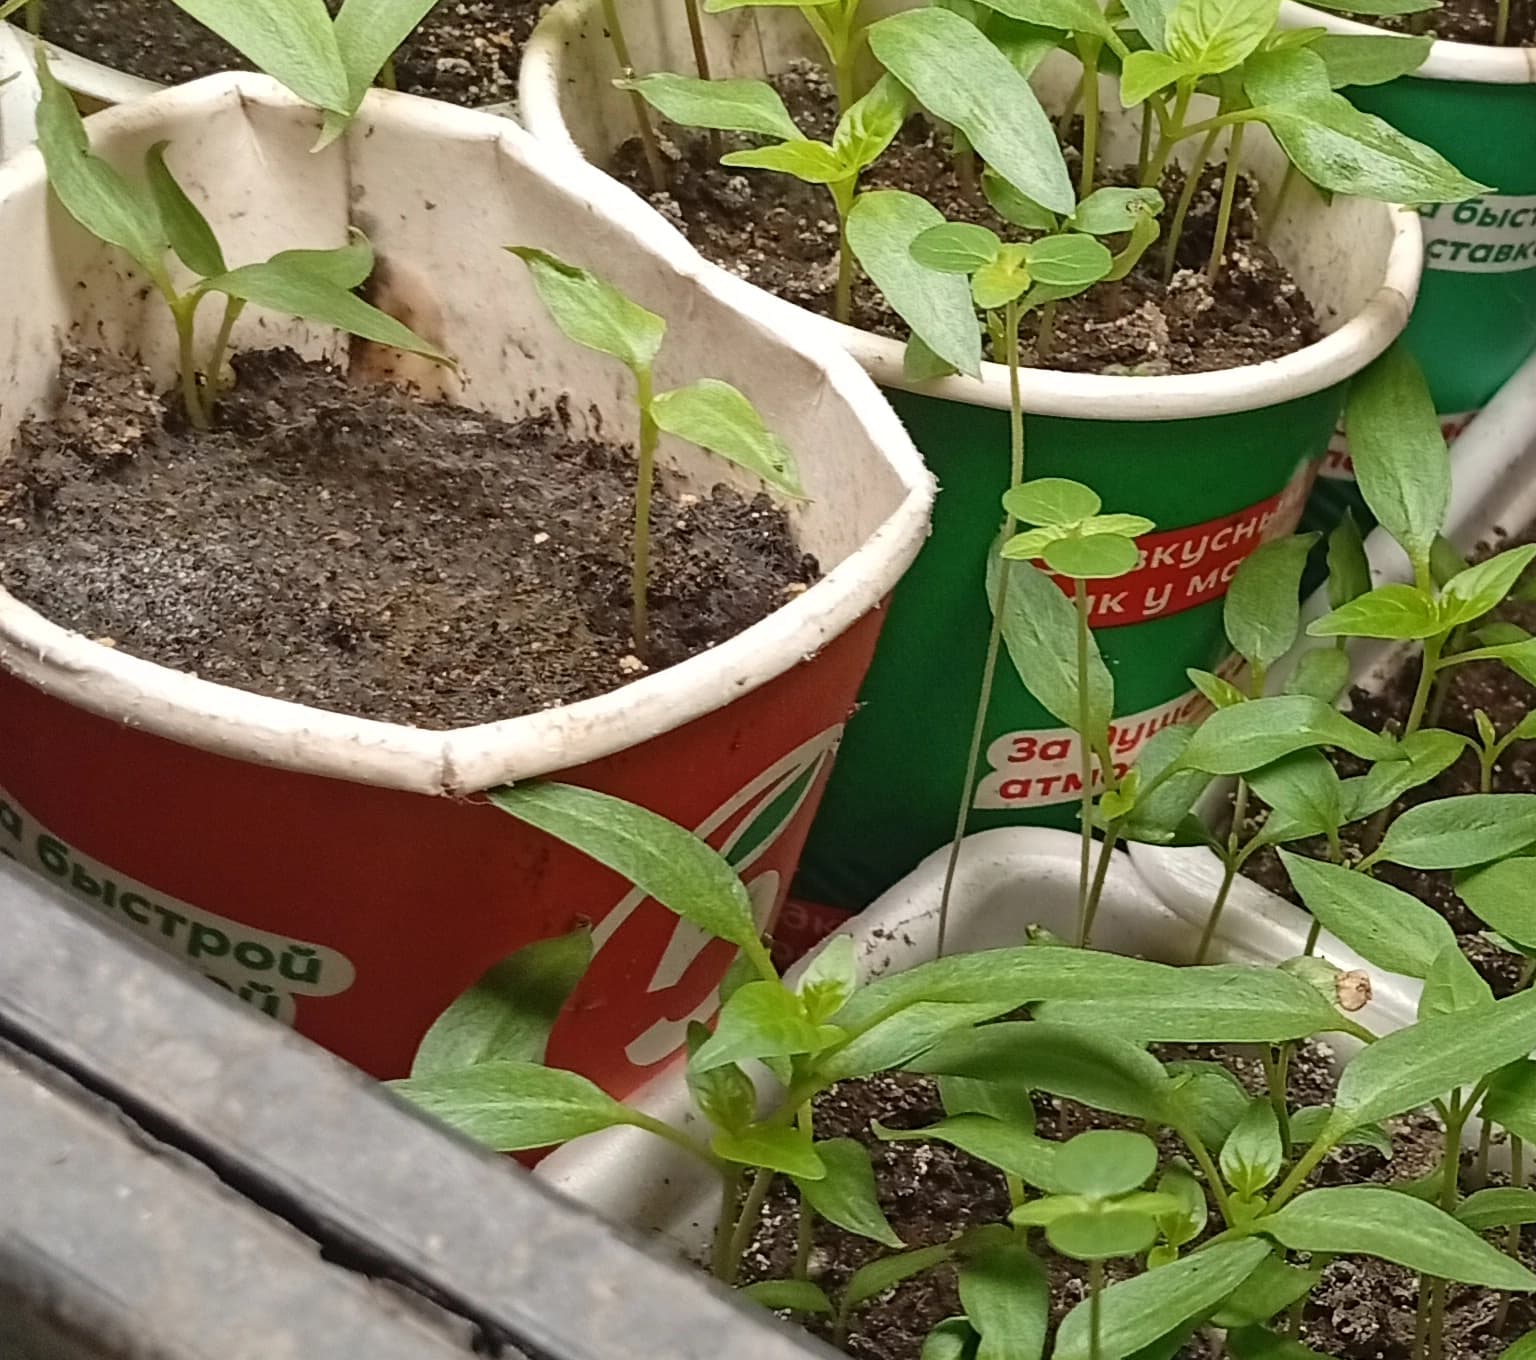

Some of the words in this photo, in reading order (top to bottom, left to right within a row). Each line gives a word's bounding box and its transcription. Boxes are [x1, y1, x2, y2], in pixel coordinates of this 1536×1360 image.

[1186, 557, 1246, 597] мо
[1008, 737, 1071, 763] За
[1000, 763, 1128, 799] атмо
[37, 834, 323, 985] быстрой
